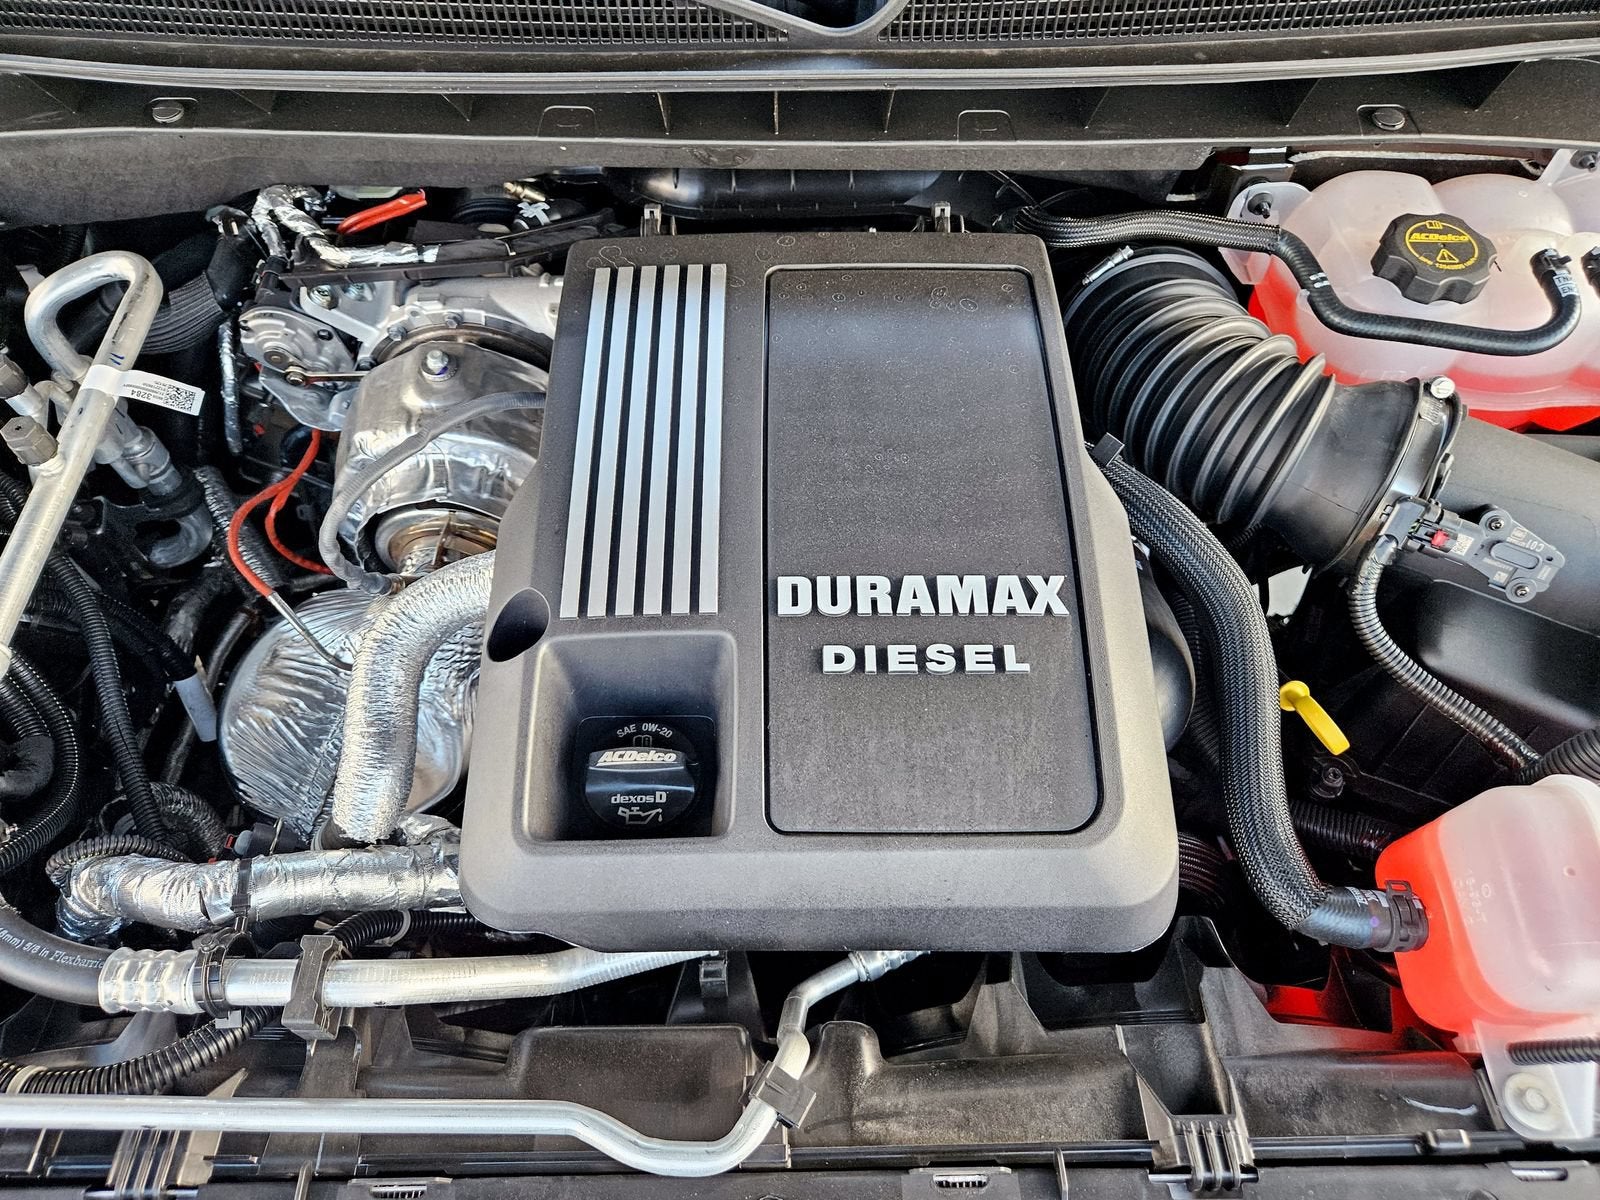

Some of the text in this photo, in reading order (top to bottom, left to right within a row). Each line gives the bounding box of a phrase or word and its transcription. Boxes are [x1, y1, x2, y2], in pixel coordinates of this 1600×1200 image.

[1409, 233, 1469, 242] ACDelco
[130, 389, 152, 401] 3284
[777, 575, 1069, 616] DURAMAX
[822, 643, 1030, 674] DIESEL
[617, 722, 673, 738] SAE 0W-20
[597, 750, 677, 763] ACDelco
[23, 942, 40, 954] 5/8
